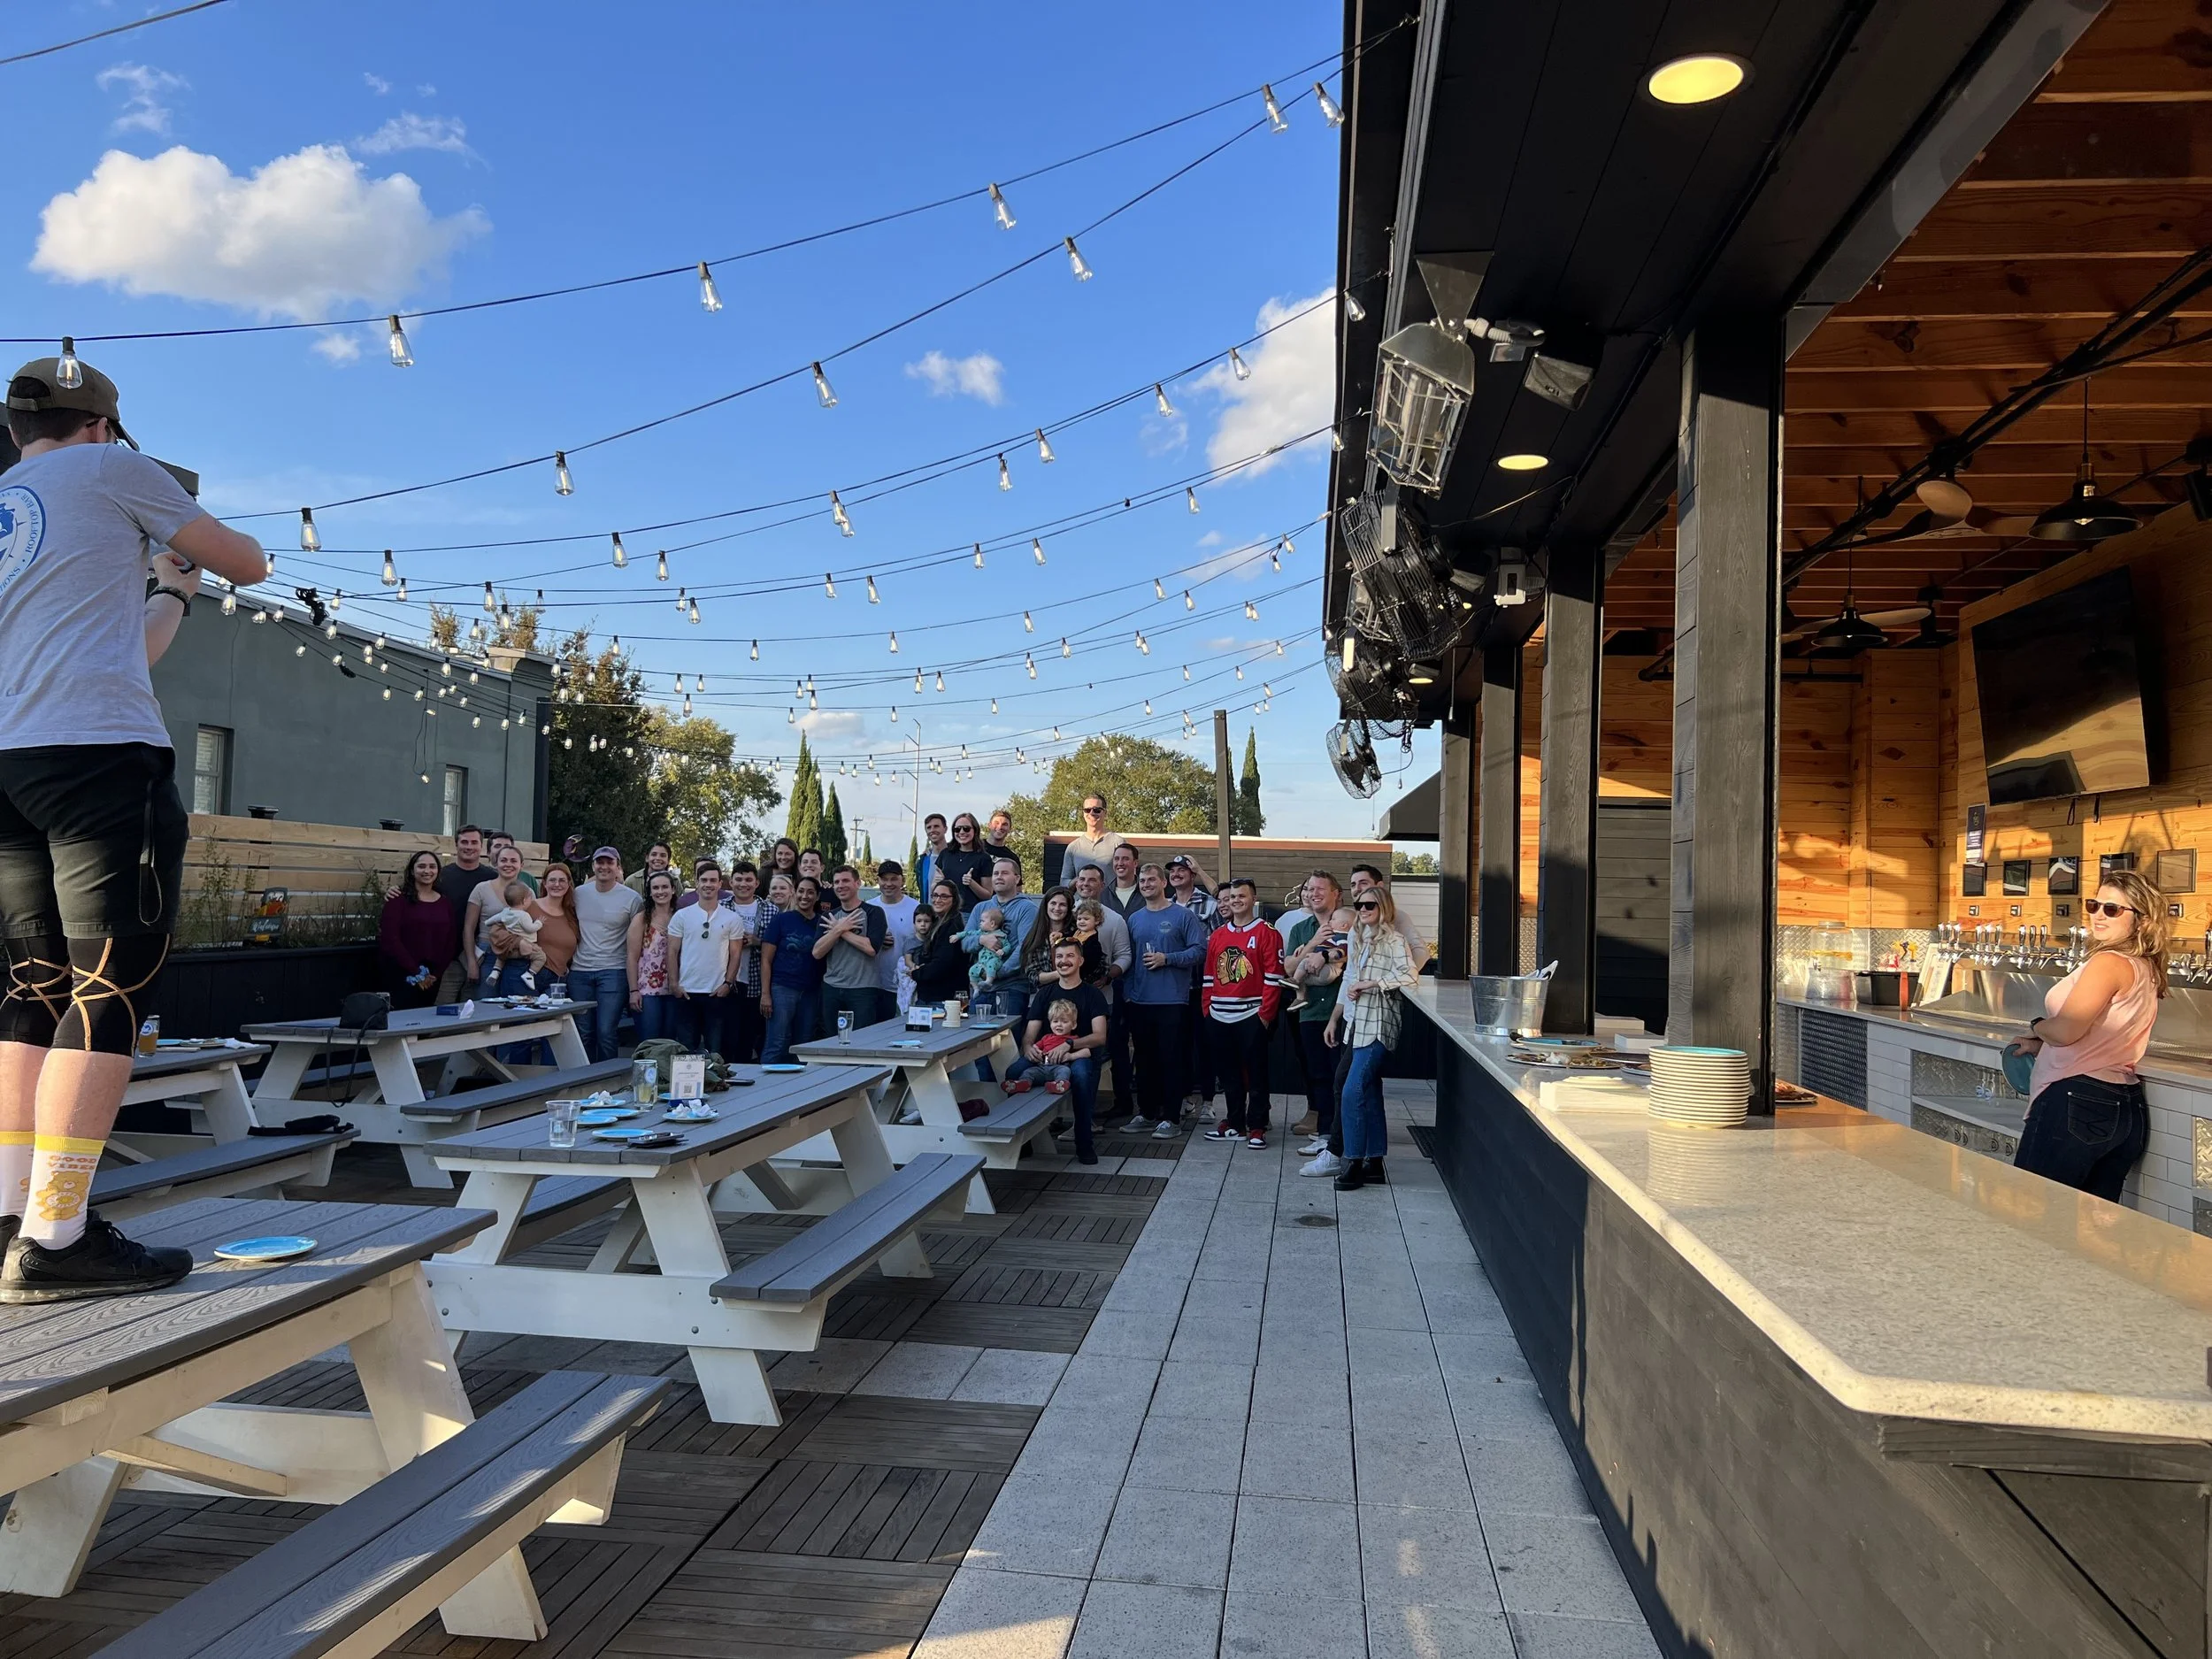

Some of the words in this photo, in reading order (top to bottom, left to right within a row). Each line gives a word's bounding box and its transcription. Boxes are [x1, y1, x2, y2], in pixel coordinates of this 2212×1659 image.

[20, 493, 34, 508] BAR
[25, 511, 38, 553] ROOFTOP
[1247, 936, 1256, 949] A
